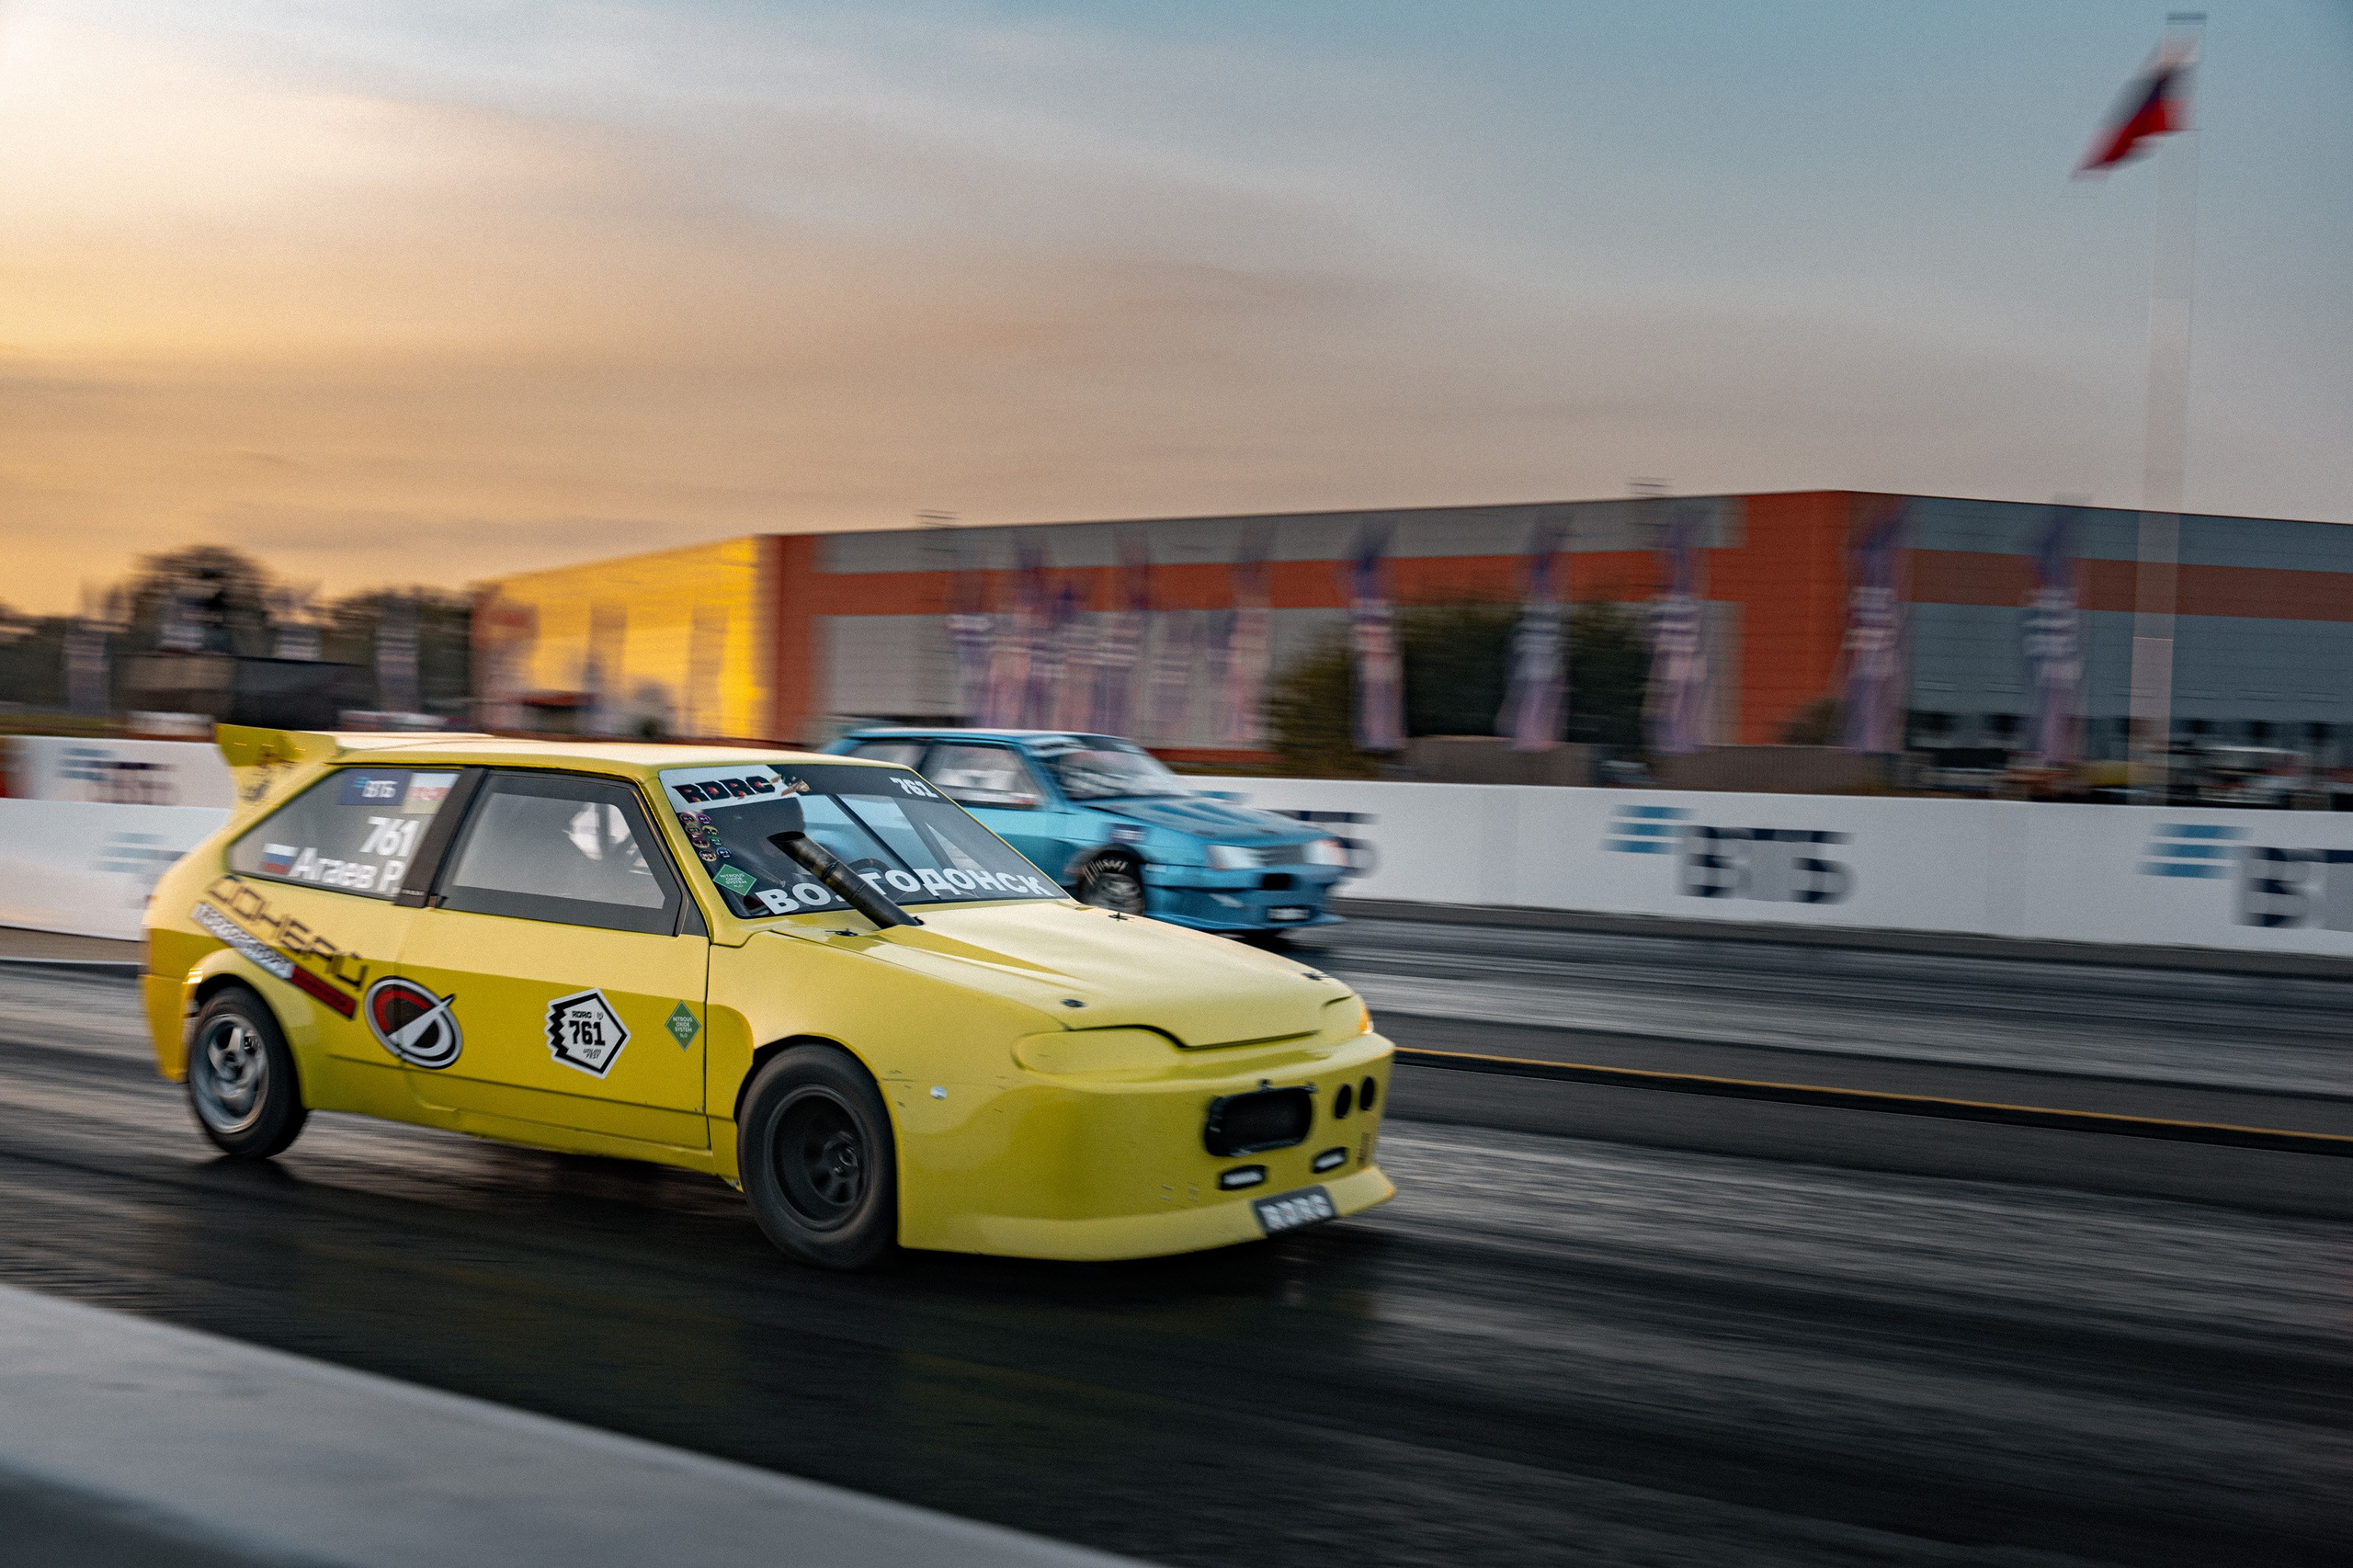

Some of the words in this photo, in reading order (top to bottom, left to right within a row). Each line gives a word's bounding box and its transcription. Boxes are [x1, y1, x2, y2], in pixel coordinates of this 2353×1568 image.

[889, 777, 938, 799] 761
[360, 816, 420, 857] 761
[288, 847, 379, 889] Агаев
[756, 868, 1055, 915] ВОГОДОНСК
[569, 1020, 606, 1046] 761
